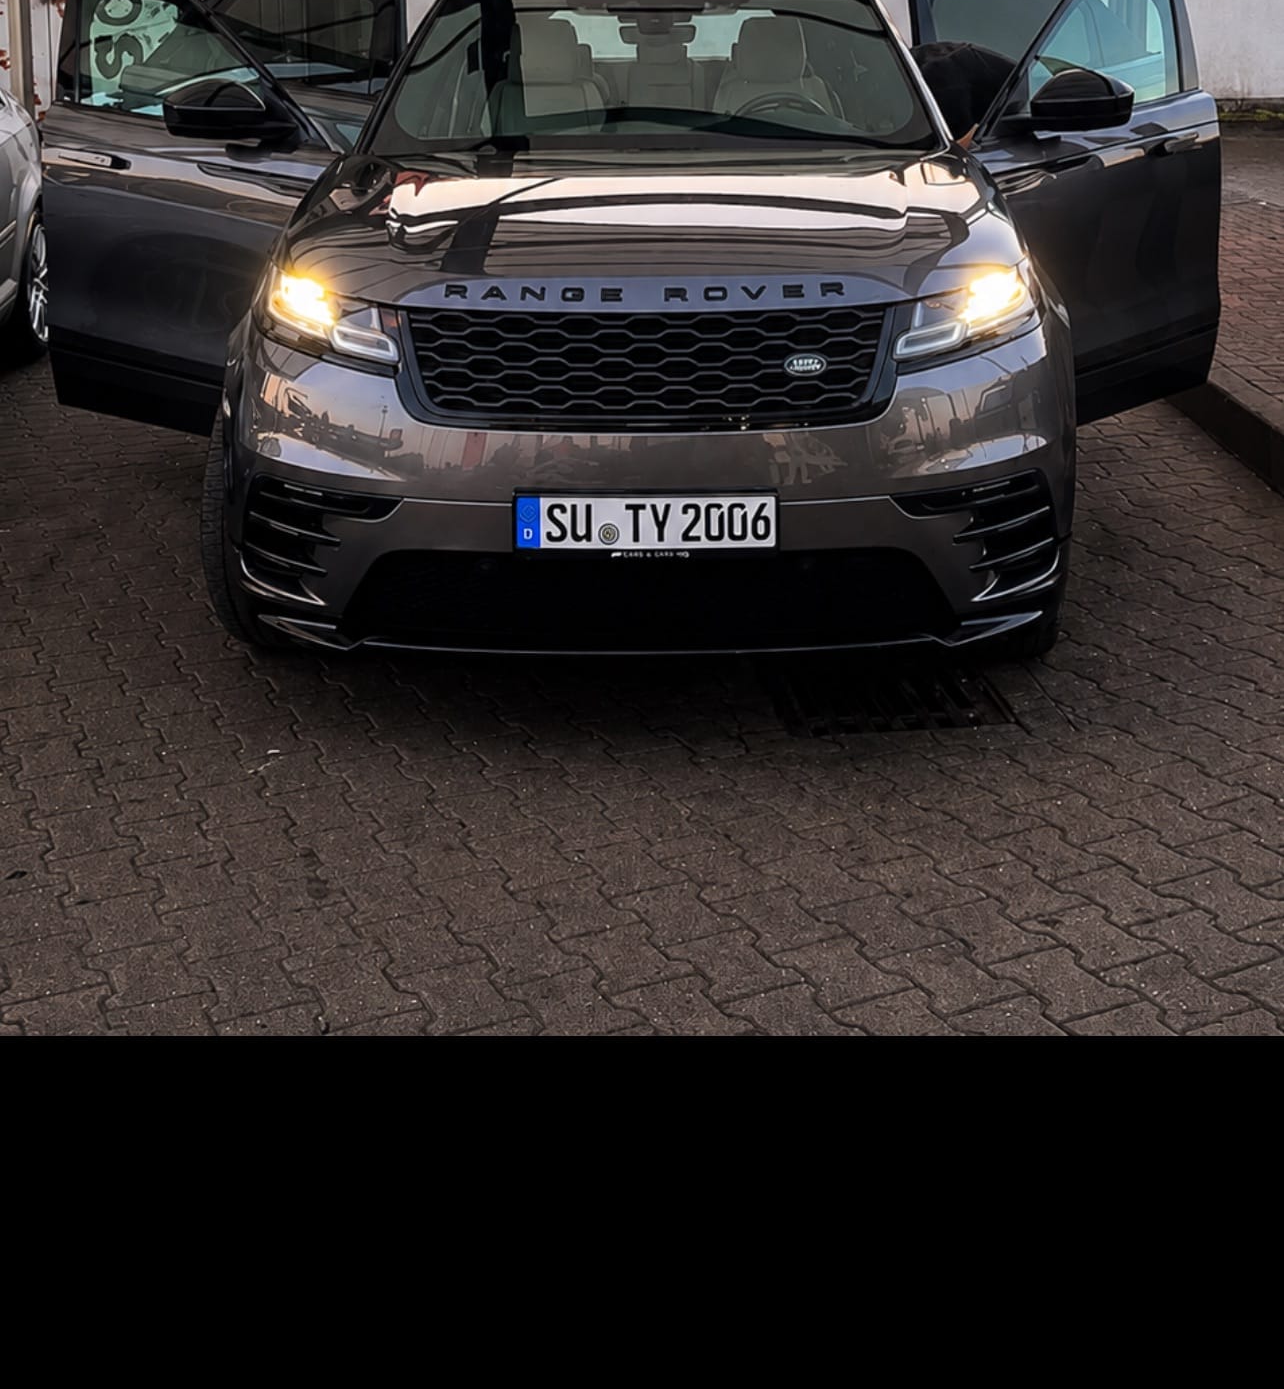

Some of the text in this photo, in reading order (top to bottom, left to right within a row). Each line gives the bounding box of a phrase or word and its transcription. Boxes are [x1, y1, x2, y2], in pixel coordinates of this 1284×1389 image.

[444, 282, 845, 302] RANGE ROVER
[546, 503, 771, 542] SU TY 2006
[523, 528, 533, 540] D
